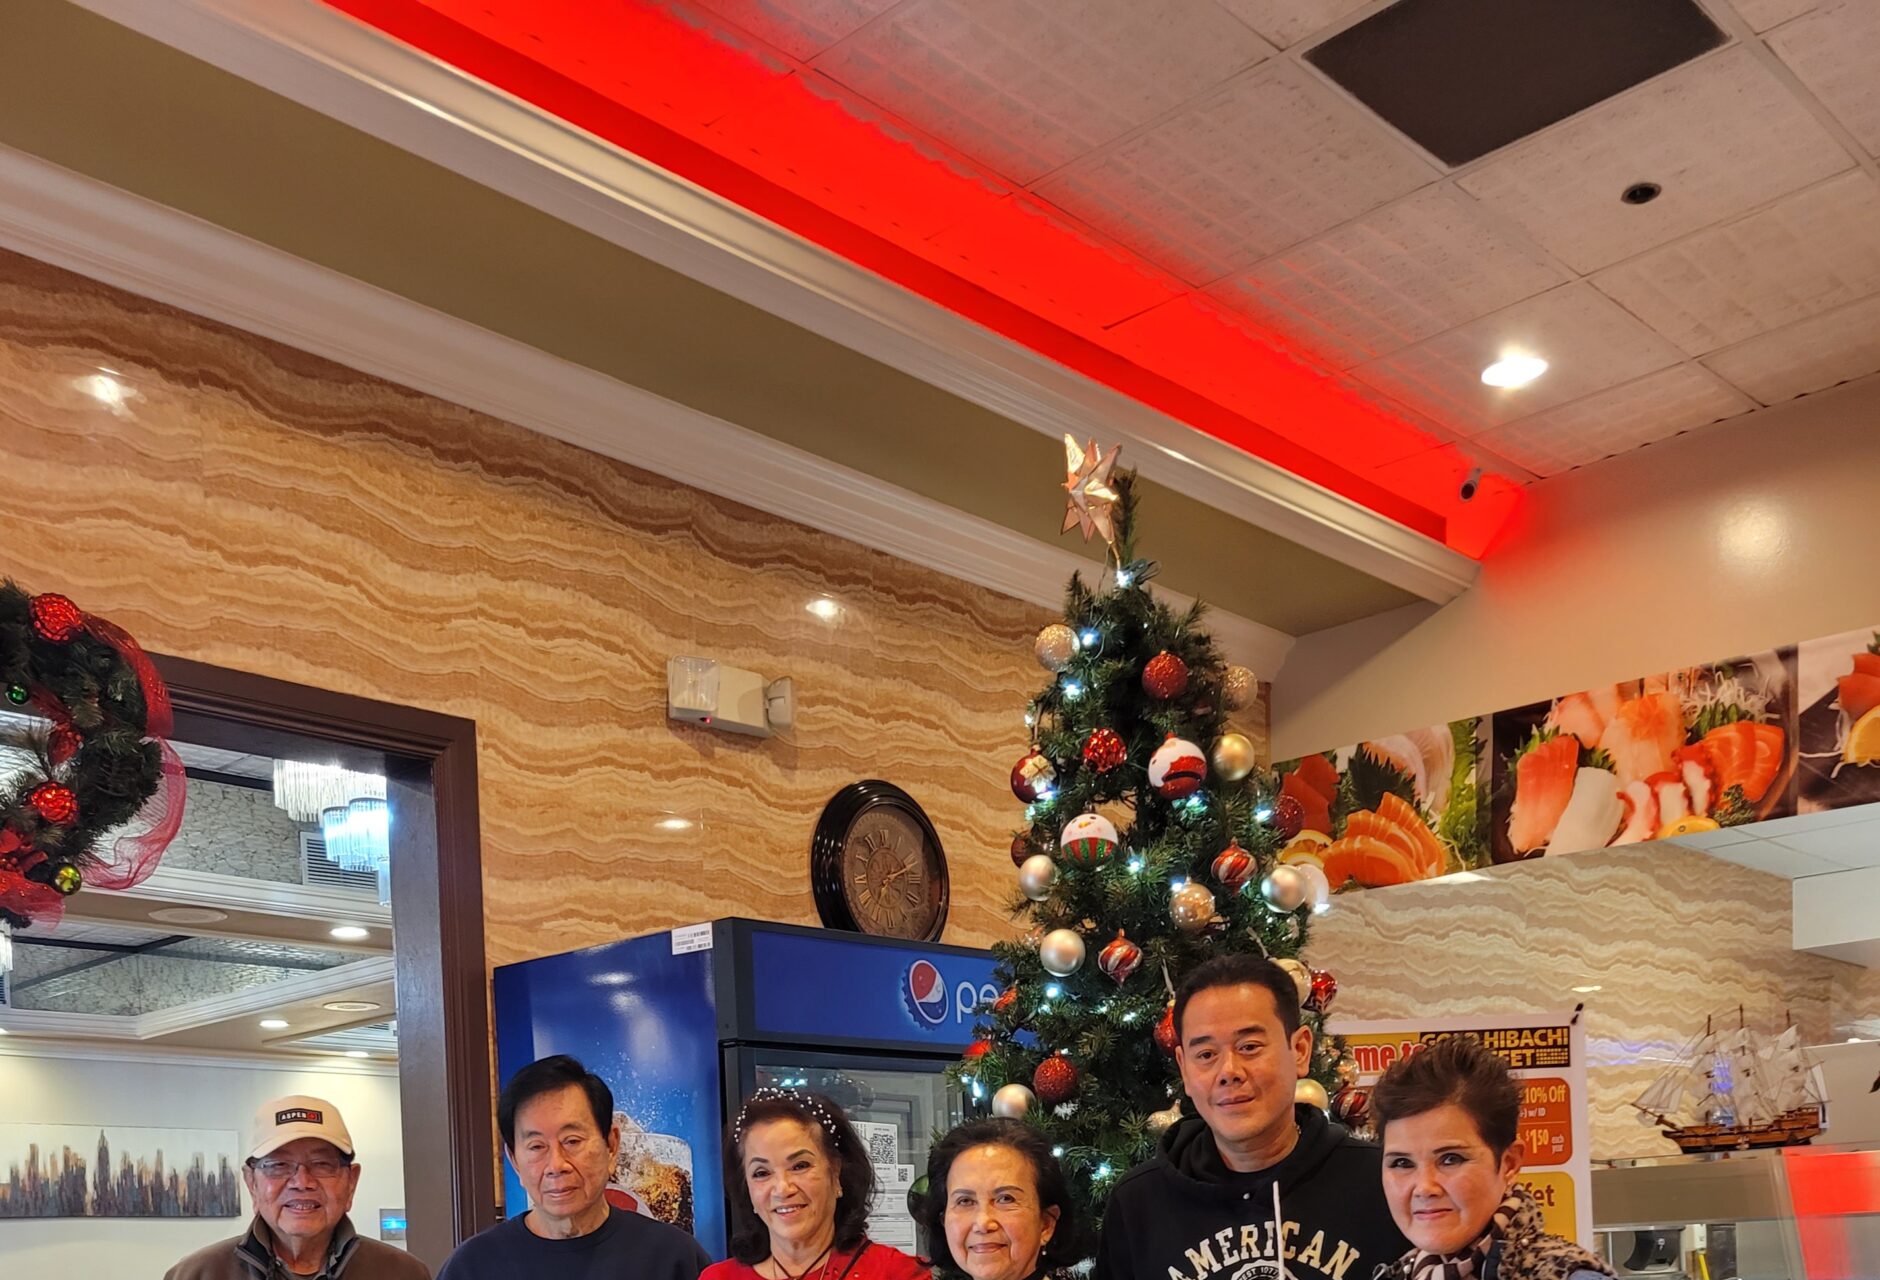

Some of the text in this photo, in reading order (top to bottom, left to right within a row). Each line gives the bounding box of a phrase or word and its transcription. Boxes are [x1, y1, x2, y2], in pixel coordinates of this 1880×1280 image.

[956, 981, 1000, 1023] pe
[1484, 1028, 1568, 1048] HIBACHI
[1353, 1045, 1396, 1071] me
[1524, 1084, 1566, 1103] 10% Off
[1241, 1268, 1257, 1280] EST
